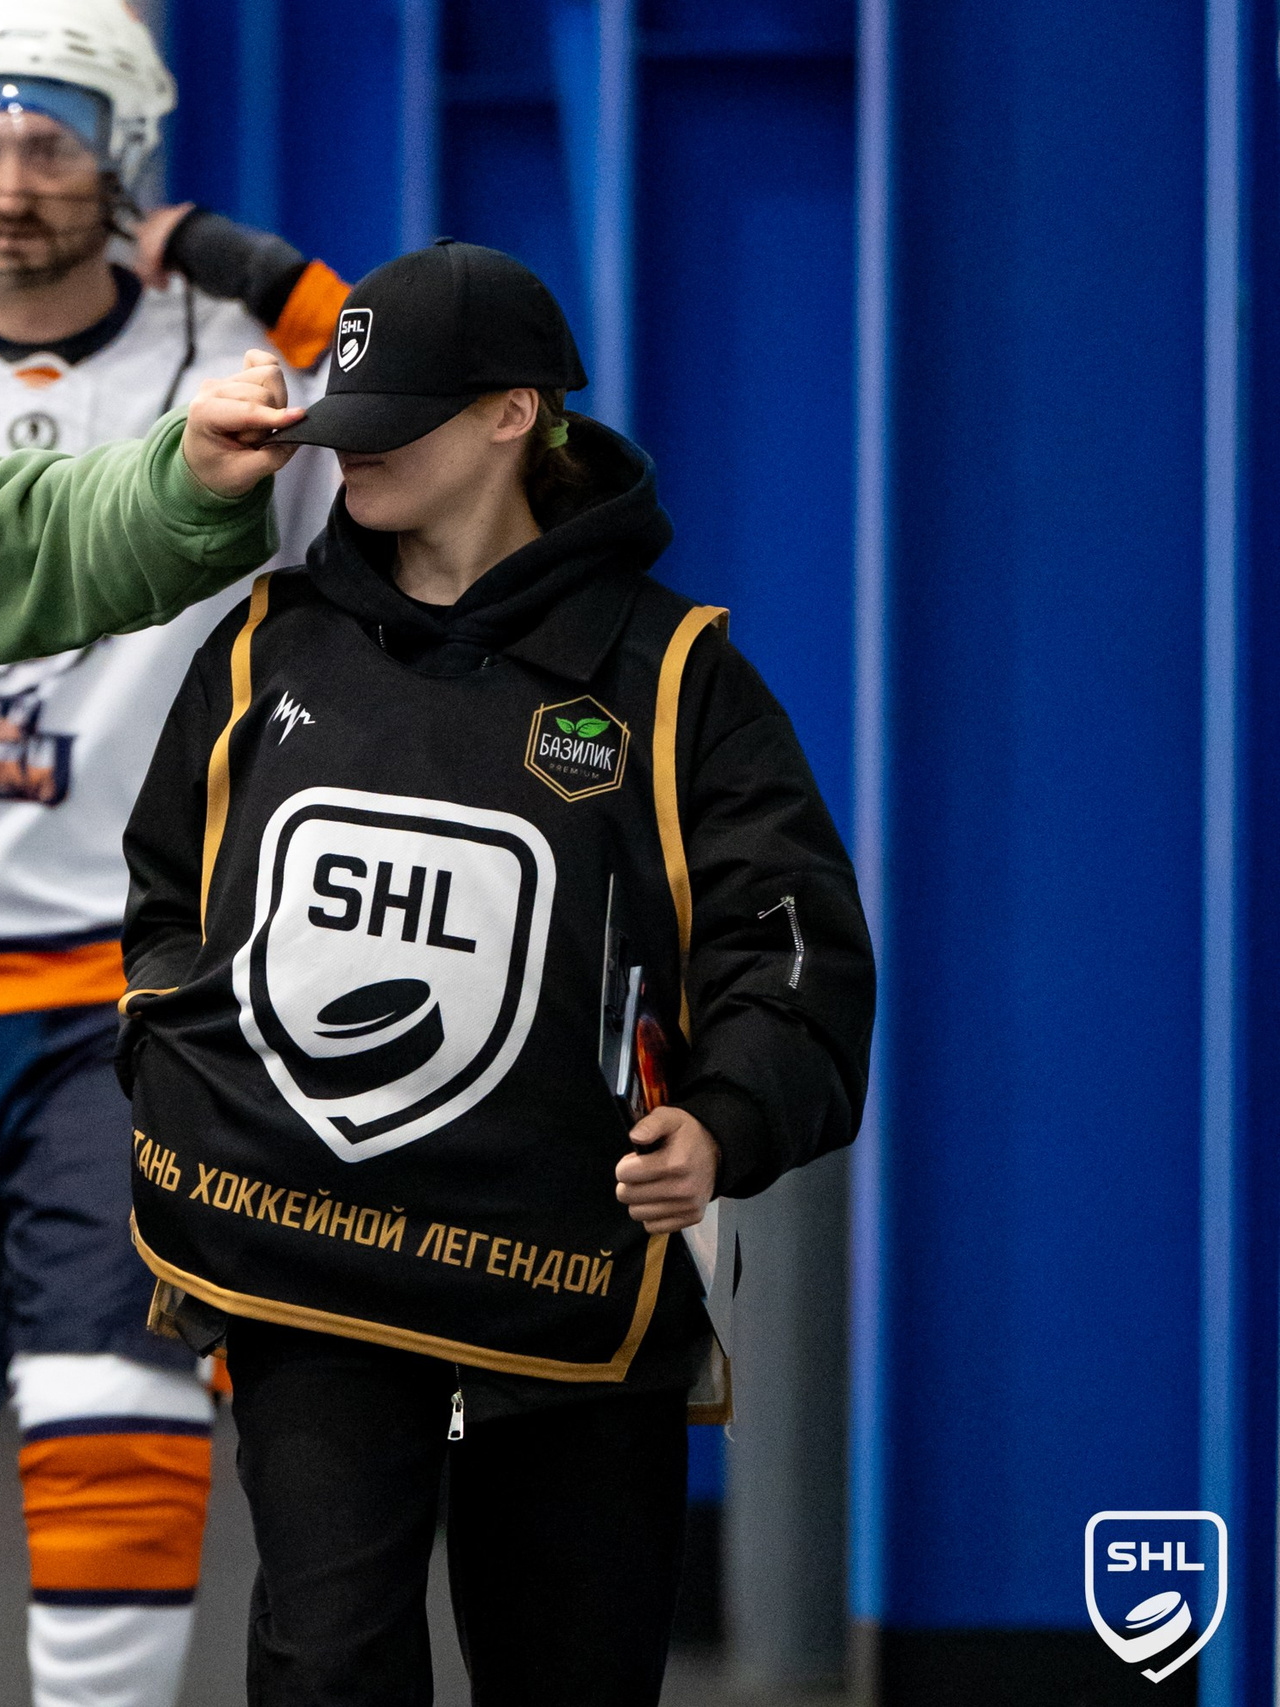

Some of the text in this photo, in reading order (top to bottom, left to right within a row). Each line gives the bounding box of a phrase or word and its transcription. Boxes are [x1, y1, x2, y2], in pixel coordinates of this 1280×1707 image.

[341, 320, 365, 334] SHL
[539, 733, 616, 772] БАЗИЛИК
[307, 853, 477, 953] SHL
[131, 1127, 614, 1297] ТАНЬ ХОККЕЙНОЙ ЛЕГЕНДОЙ
